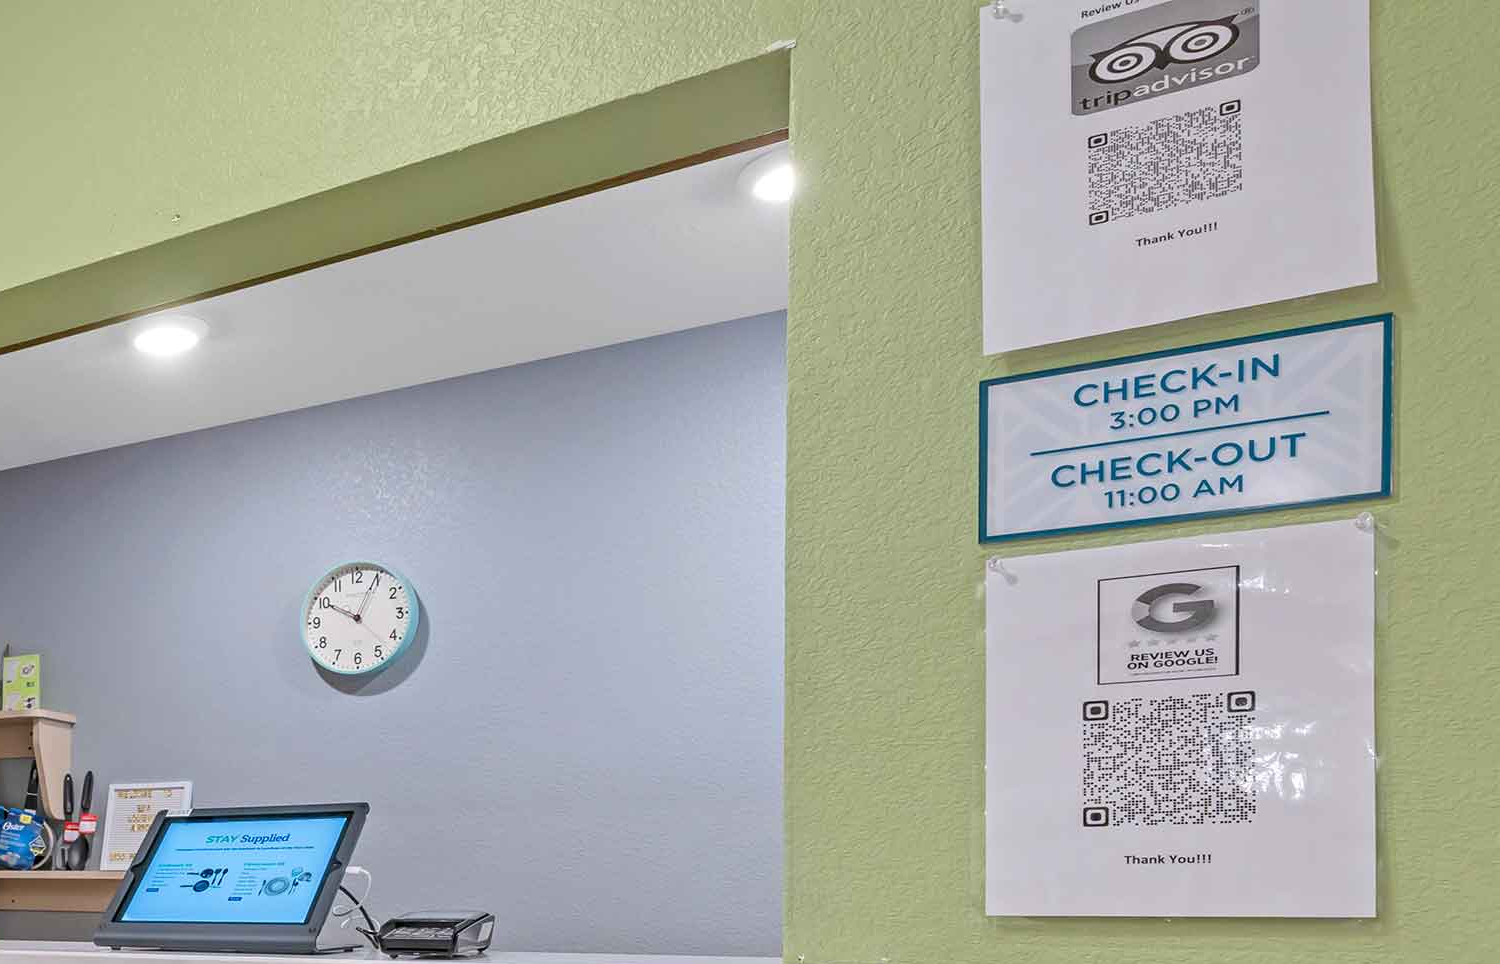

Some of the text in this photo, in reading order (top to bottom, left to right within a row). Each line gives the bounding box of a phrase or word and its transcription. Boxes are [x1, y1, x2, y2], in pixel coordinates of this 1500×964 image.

[1081, 2, 1122, 19] Review
[1079, 57, 1250, 111] tripadvisor
[1135, 222, 1219, 248] Thank You!!!
[1073, 353, 1281, 407] CHECK-IN
[1109, 394, 1240, 430] 3:00 PM
[1051, 432, 1307, 488] CHECK-OUT
[1104, 475, 1244, 508] 11:00 AM
[351, 571, 363, 584] 12
[334, 579, 342, 593] 11
[389, 586, 397, 600] 2
[319, 597, 330, 609] 10
[396, 607, 404, 620] 3
[312, 617, 321, 629] 9
[389, 629, 398, 641] 4
[319, 636, 327, 649] 8
[334, 649, 342, 661] 7
[374, 645, 382, 658] 5
[1130, 648, 1215, 662] REVIEW US
[354, 652, 362, 665] 6
[1127, 656, 1218, 670] ON GOOGLE!
[205, 833, 292, 845] STAY Supplied
[1124, 854, 1212, 865] Thank You!!!
